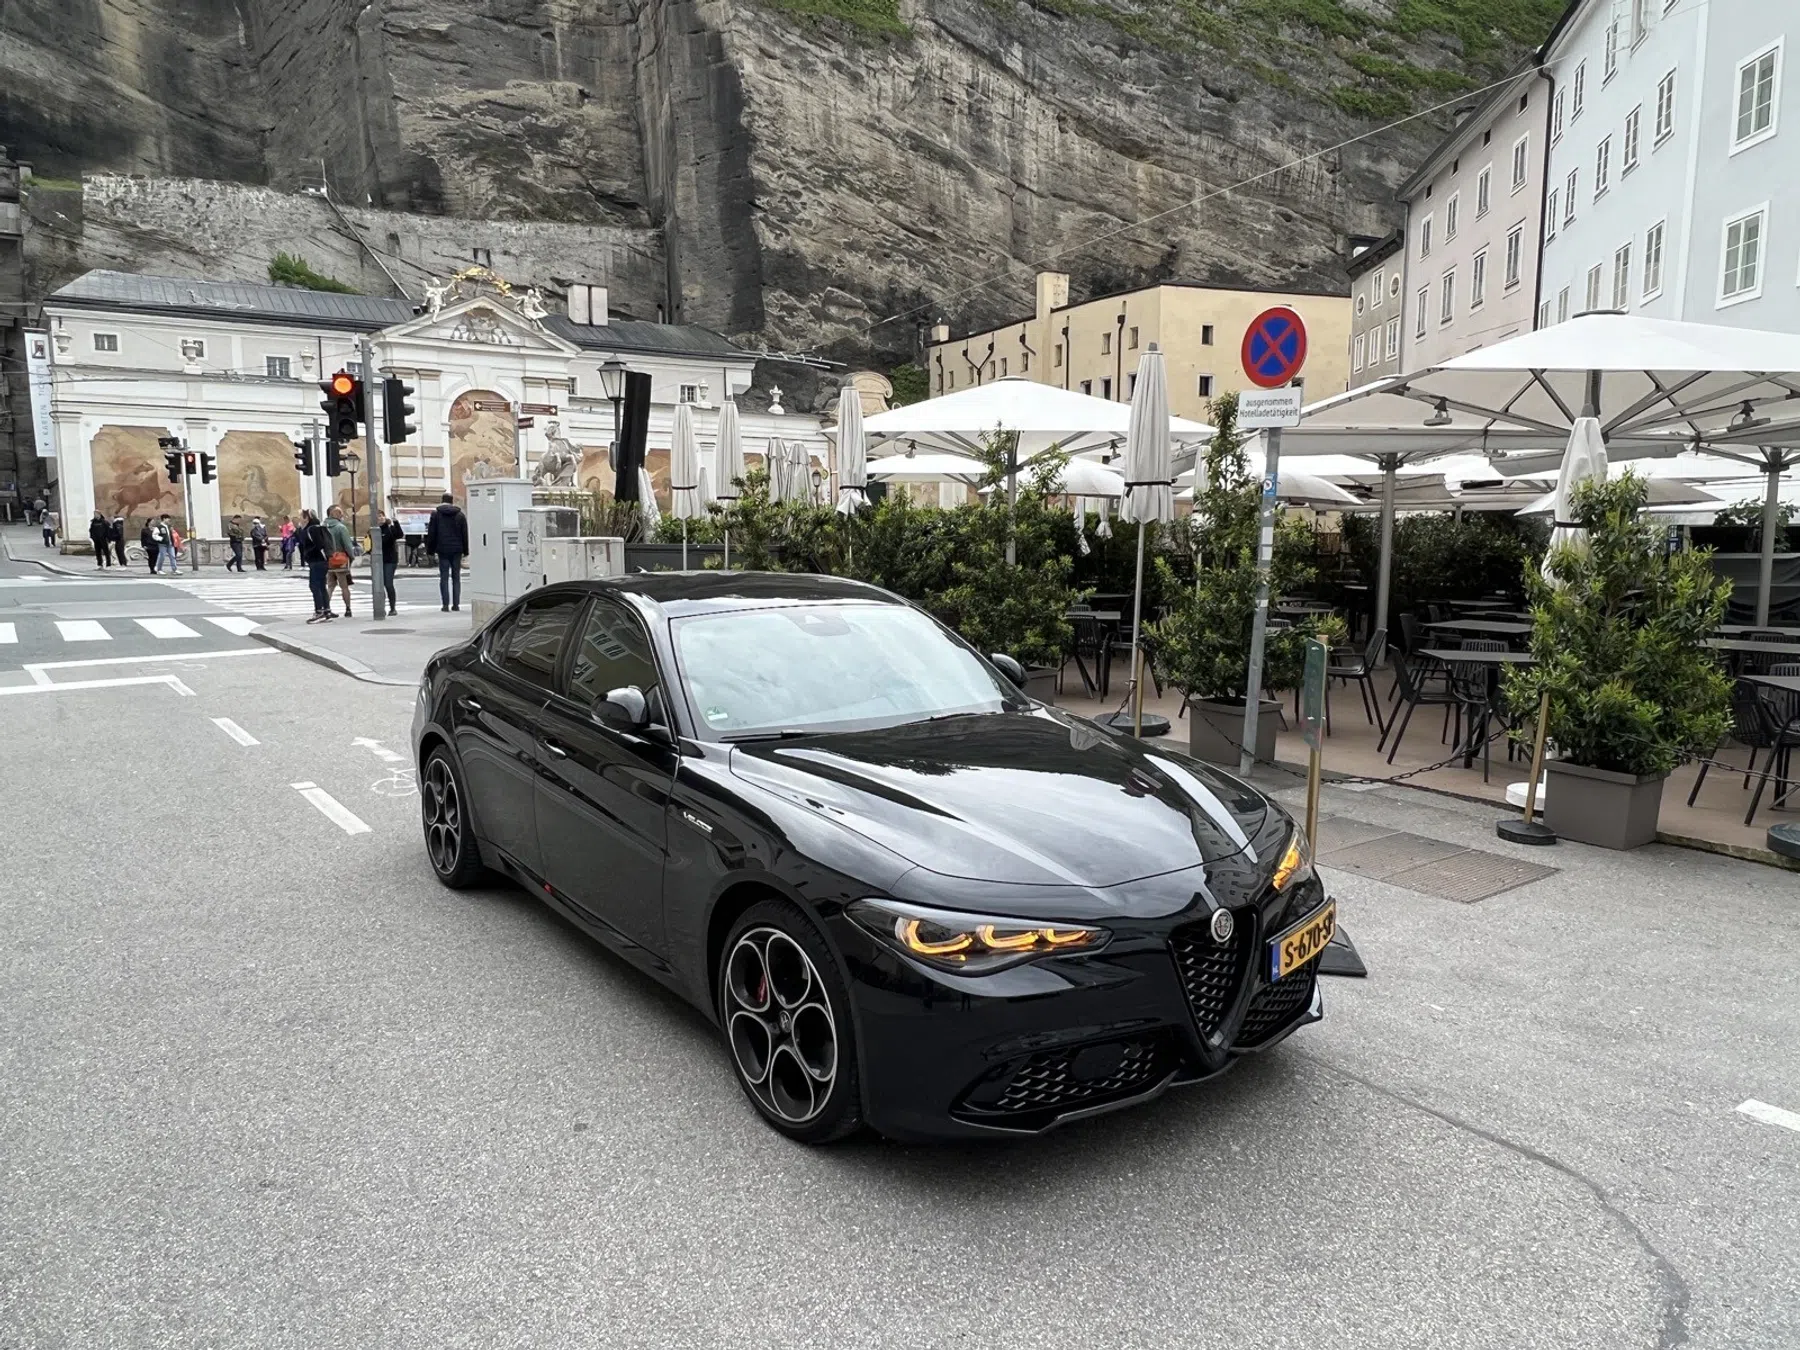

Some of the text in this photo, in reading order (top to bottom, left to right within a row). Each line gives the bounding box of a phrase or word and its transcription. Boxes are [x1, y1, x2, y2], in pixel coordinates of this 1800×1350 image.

[1246, 398, 1294, 409] ausgenommen
[1240, 407, 1299, 419] Hotelladetätigkeit
[40, 404, 48, 436] KARTEN
